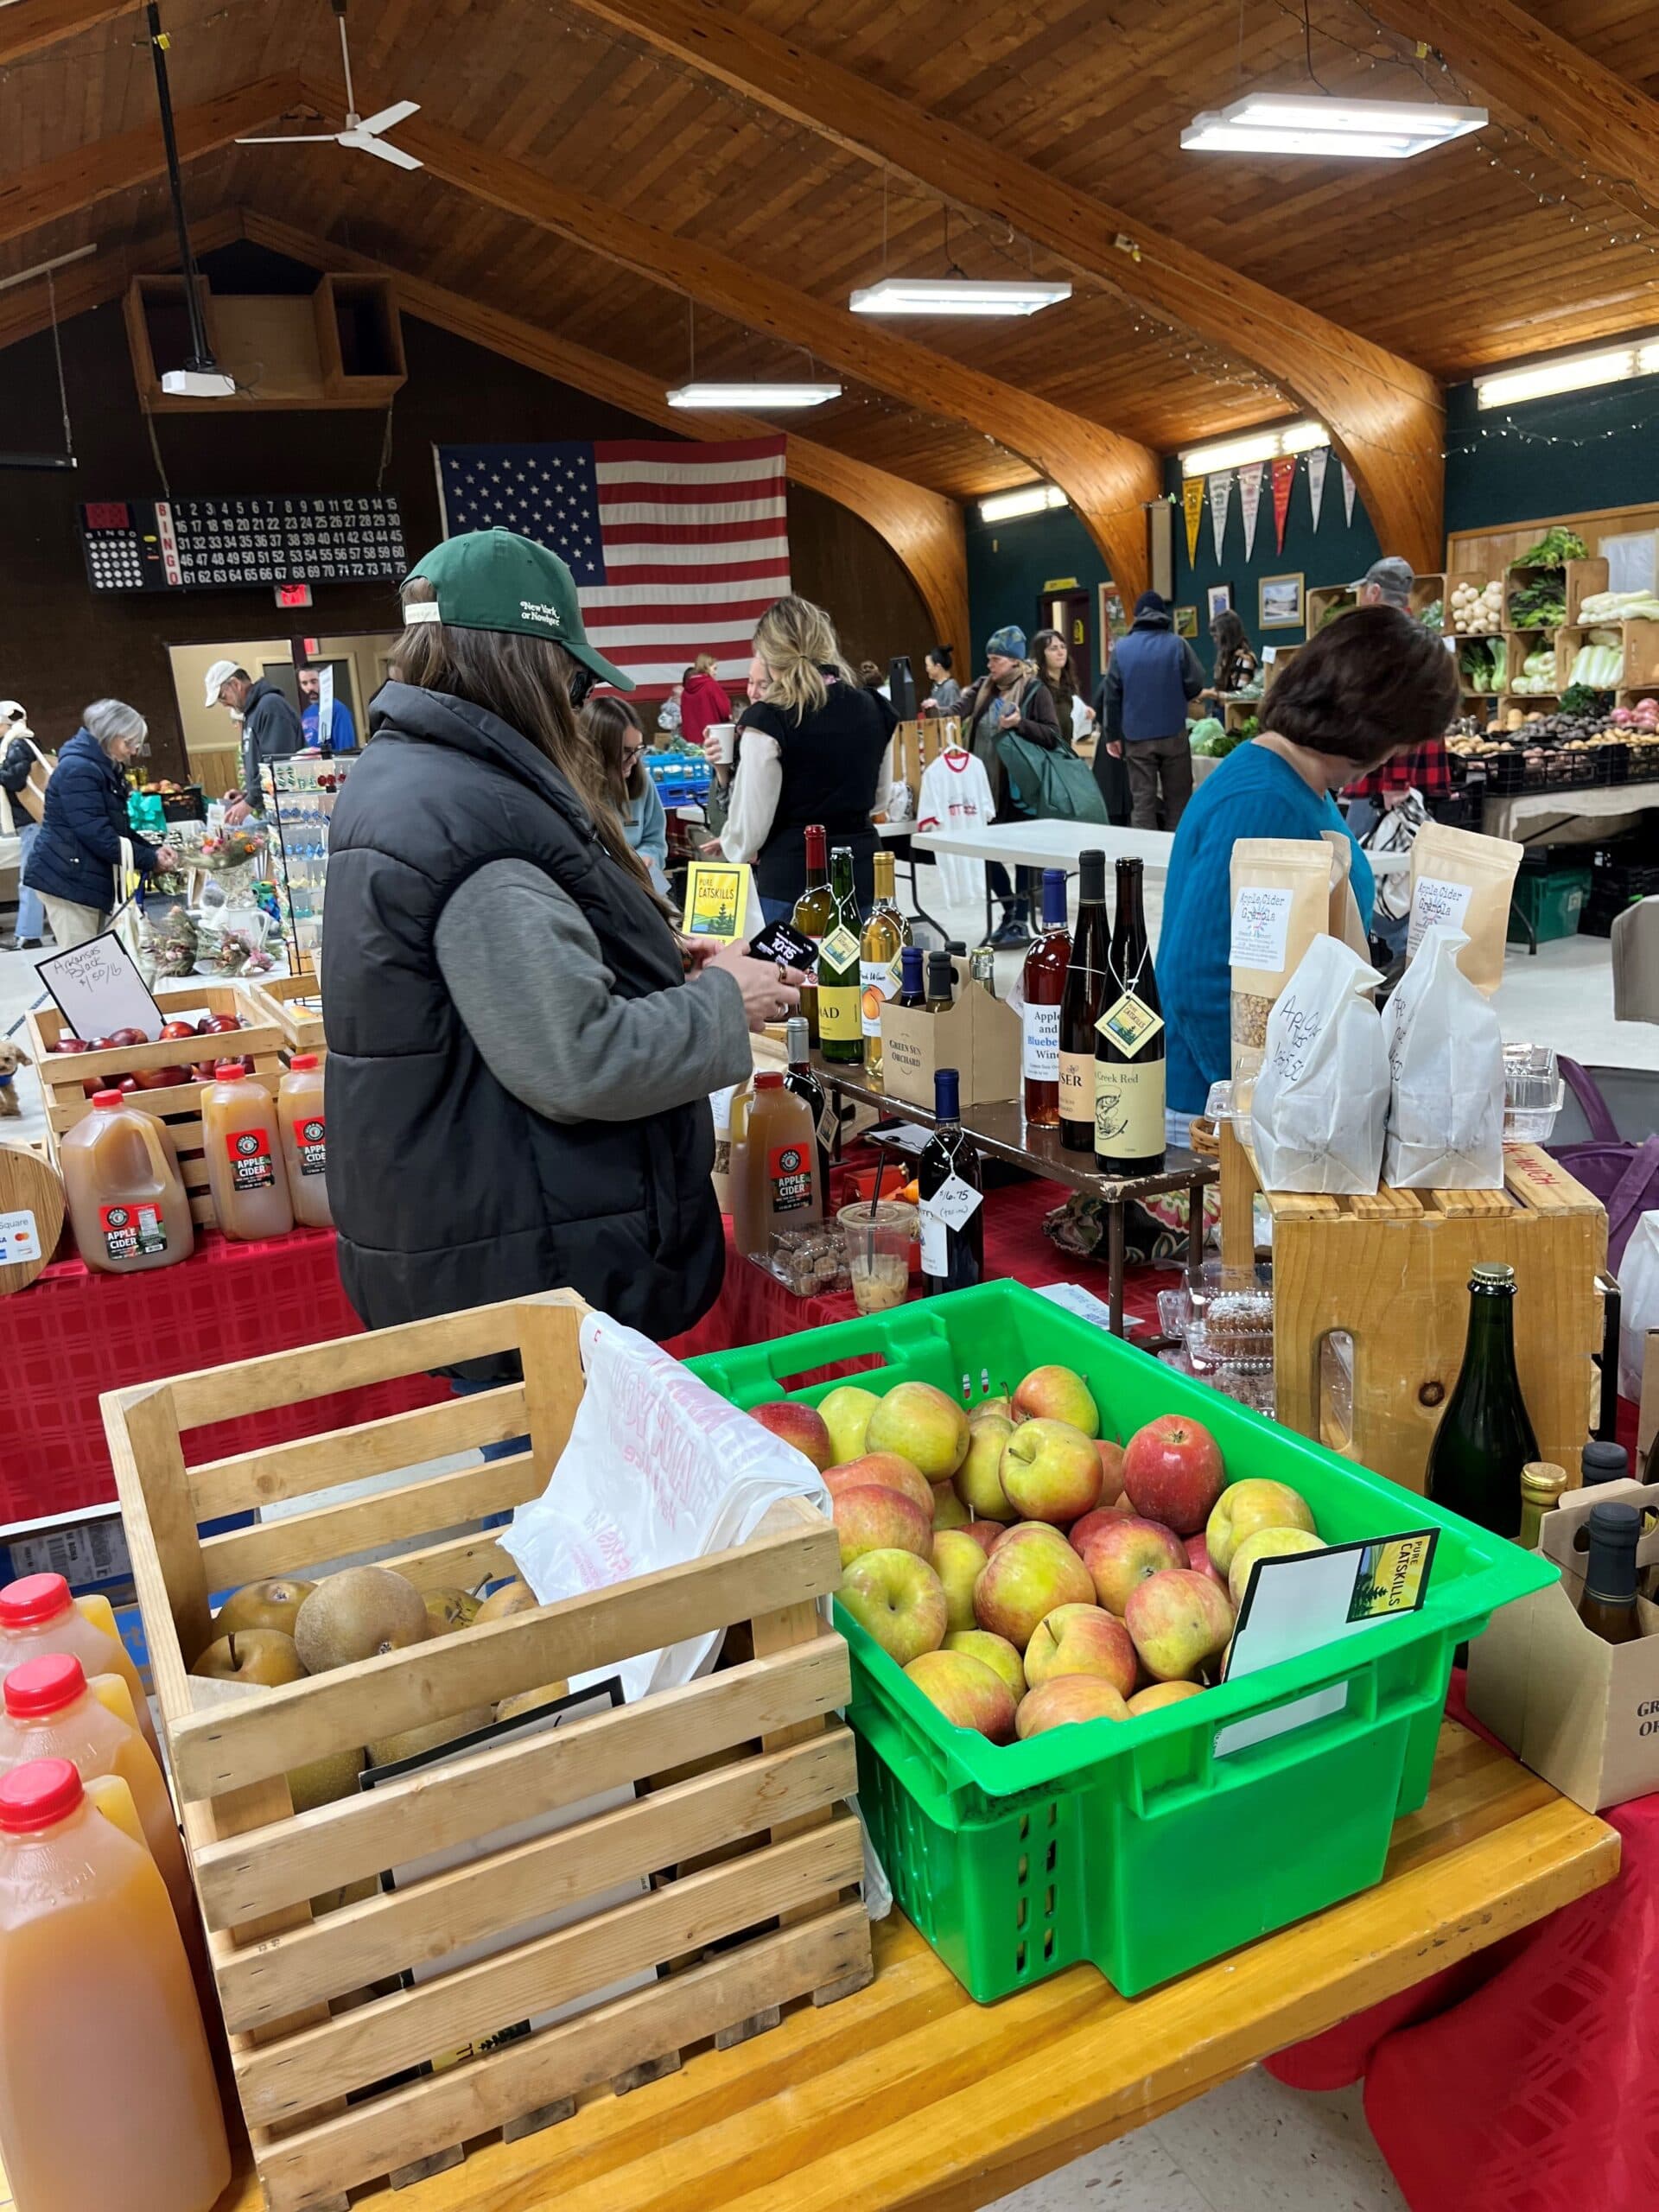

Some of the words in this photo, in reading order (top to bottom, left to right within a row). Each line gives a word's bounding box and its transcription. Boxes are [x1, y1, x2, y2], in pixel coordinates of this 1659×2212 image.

[175, 504, 181, 516] 1
[190, 503, 198, 515] 2
[206, 503, 213, 515] 3
[221, 502, 228, 514] 4
[237, 502, 244, 514] 5
[252, 501, 259, 514] 6
[267, 501, 273, 512] 7
[285, 501, 292, 512] 8
[301, 500, 308, 512] 9
[313, 500, 324, 512] 10
[328, 500, 339, 512] 11
[343, 499, 353, 512] 12
[358, 499, 369, 511] 13
[372, 499, 382, 510] 14
[386, 499, 397, 510] 15
[175, 520, 188, 532] 16
[191, 520, 201, 531] 17
[207, 519, 218, 531] 18
[222, 519, 233, 531] 19
[237, 518, 250, 531] 20
[252, 518, 264, 531] 21
[267, 518, 280, 530] 22
[285, 518, 297, 529] 23
[301, 517, 312, 529] 24
[315, 517, 327, 528] 25
[330, 516, 342, 528] 26
[345, 515, 356, 527] 27
[359, 515, 372, 526] 28
[373, 514, 385, 526] 29
[388, 514, 400, 526] 30
[178, 537, 190, 550] 31
[194, 537, 206, 550] 32
[209, 537, 222, 549] 33
[224, 537, 237, 549] 34
[239, 536, 252, 547] 35
[255, 535, 267, 547] 36
[270, 535, 282, 546] 37
[287, 534, 300, 546] 38
[302, 534, 315, 545] 39
[318, 533, 330, 544] 40
[333, 533, 345, 543] 41
[347, 532, 359, 543] 42
[362, 531, 374, 543] 43
[376, 531, 388, 542] 44
[391, 531, 403, 542] 45
[181, 554, 194, 566] 46
[196, 554, 207, 565] 47
[211, 553, 225, 565] 48
[226, 553, 239, 564] 49
[242, 552, 255, 563] 50
[257, 551, 270, 563] 51
[272, 551, 285, 563] 52
[289, 550, 302, 563] 53
[304, 550, 317, 561] 54
[320, 549, 333, 561] 55
[334, 548, 346, 560] 56
[349, 548, 361, 560] 57
[364, 547, 376, 559] 58
[378, 547, 390, 558] 59
[392, 546, 404, 557] 60
[183, 571, 195, 583] 61
[199, 571, 212, 582] 62
[214, 570, 227, 582] 63
[229, 569, 242, 581] 64
[244, 569, 257, 581] 65
[260, 569, 272, 580] 66
[275, 568, 287, 579] 67
[293, 567, 305, 579] 68
[307, 566, 321, 577] 69
[321, 565, 334, 576] 70
[337, 565, 349, 576] 71
[351, 564, 365, 575] 72
[366, 563, 378, 575] 73
[380, 563, 392, 574] 74
[396, 563, 407, 574] 75
[520, 601, 541, 611] New
[540, 604, 560, 619] York
[531, 612, 560, 626] Nowhere
[698, 887, 734, 899] CATSKILLS
[1262, 893, 1285, 906] Cider
[1440, 887, 1462, 901] Cider
[772, 938, 797, 960] 10:15
[54, 946, 100, 974] Arkansas
[1122, 1007, 1147, 1030] CATSKILLS
[1039, 1024, 1058, 1033] and
[1027, 1035, 1058, 1046] Bluebe
[1059, 1072, 1082, 1086] SER
[1097, 1071, 1117, 1083] Creek
[1120, 1074, 1139, 1084] Red
[304, 1143, 326, 1154] APPL
[238, 1156, 265, 1168] APPLE
[306, 1152, 326, 1162] CIDE
[239, 1166, 266, 1177] CIDER
[1513, 1159, 1560, 1186] MUCH
[779, 1174, 805, 1187] APPLE
[779, 1184, 805, 1196] CIDER
[108, 1228, 137, 1241] APPLE
[110, 1237, 137, 1249] CIDER
[1413, 1541, 1422, 1566] PURE
[1388, 1542, 1413, 1607] CATSKILLS
